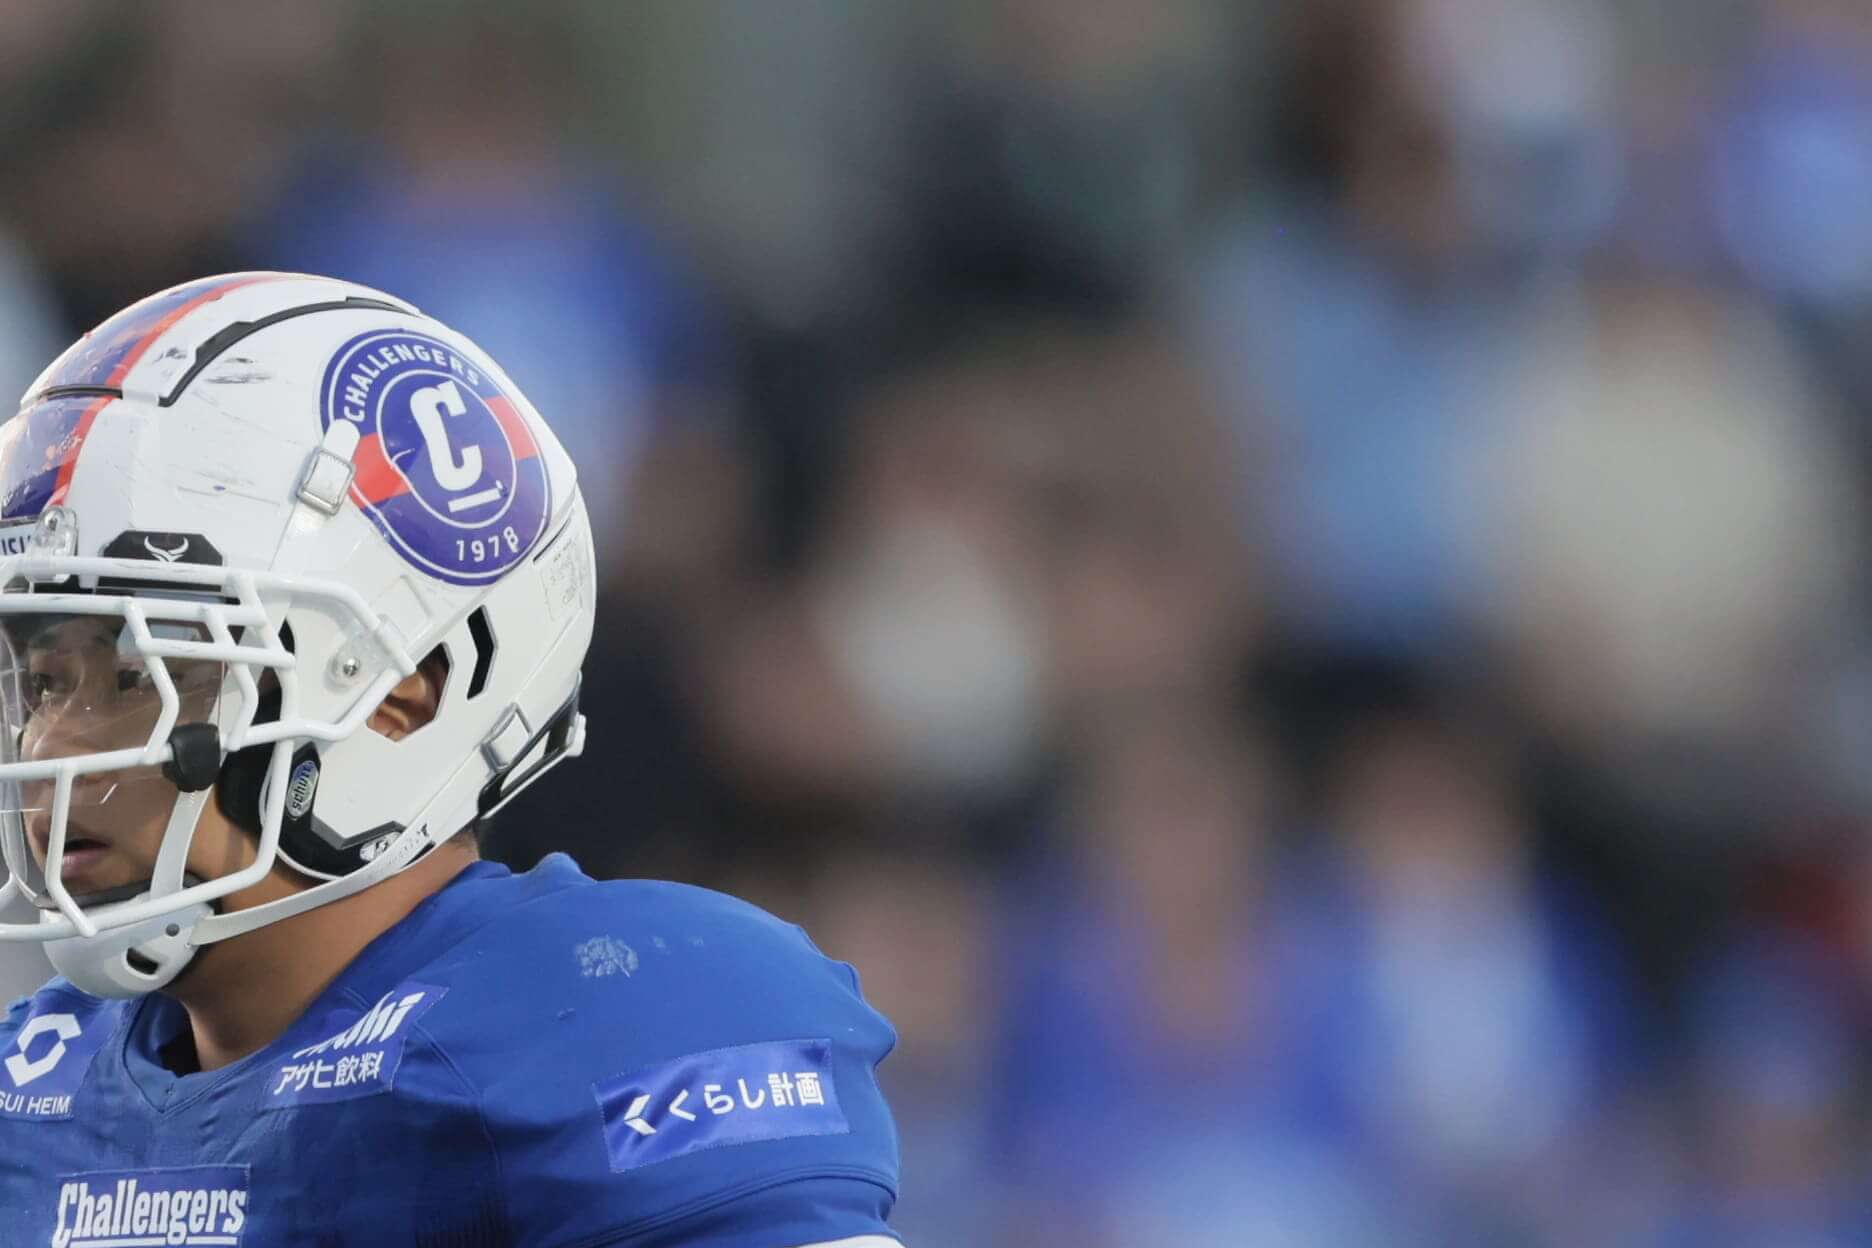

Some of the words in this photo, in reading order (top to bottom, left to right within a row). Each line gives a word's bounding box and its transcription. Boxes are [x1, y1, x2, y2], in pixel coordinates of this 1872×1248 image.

[344, 344, 478, 422] CHALLENGERS
[409, 380, 483, 491] C
[456, 526, 520, 562] 1978
[274, 1051, 384, 1095] アサヒ飲料
[668, 1071, 825, 1122] くらし計画
[26, 1095, 71, 1115] HEIM
